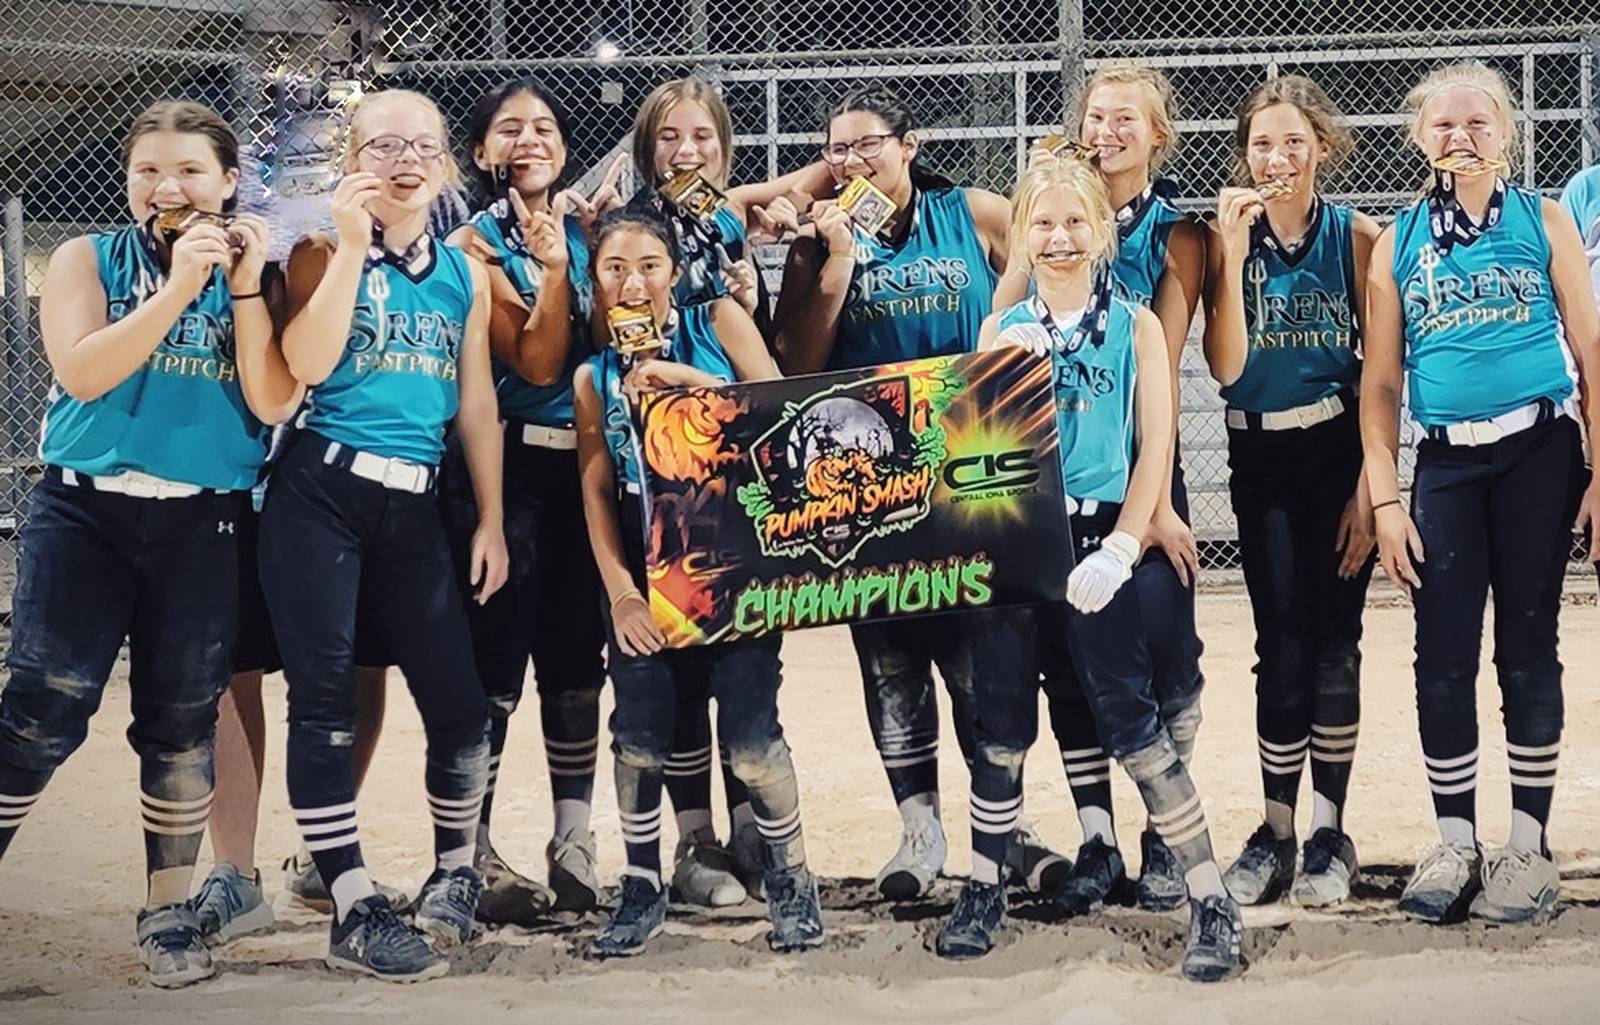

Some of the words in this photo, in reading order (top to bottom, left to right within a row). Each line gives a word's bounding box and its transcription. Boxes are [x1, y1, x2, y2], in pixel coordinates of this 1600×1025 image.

[1249, 329, 1350, 349] ASTPITCH
[148, 351, 236, 382] TPITCH
[943, 447, 1041, 493] CIS
[764, 487, 857, 545] PUMPKIN
[861, 464, 930, 513] SMASH
[733, 556, 994, 634] CHAMPIONS
